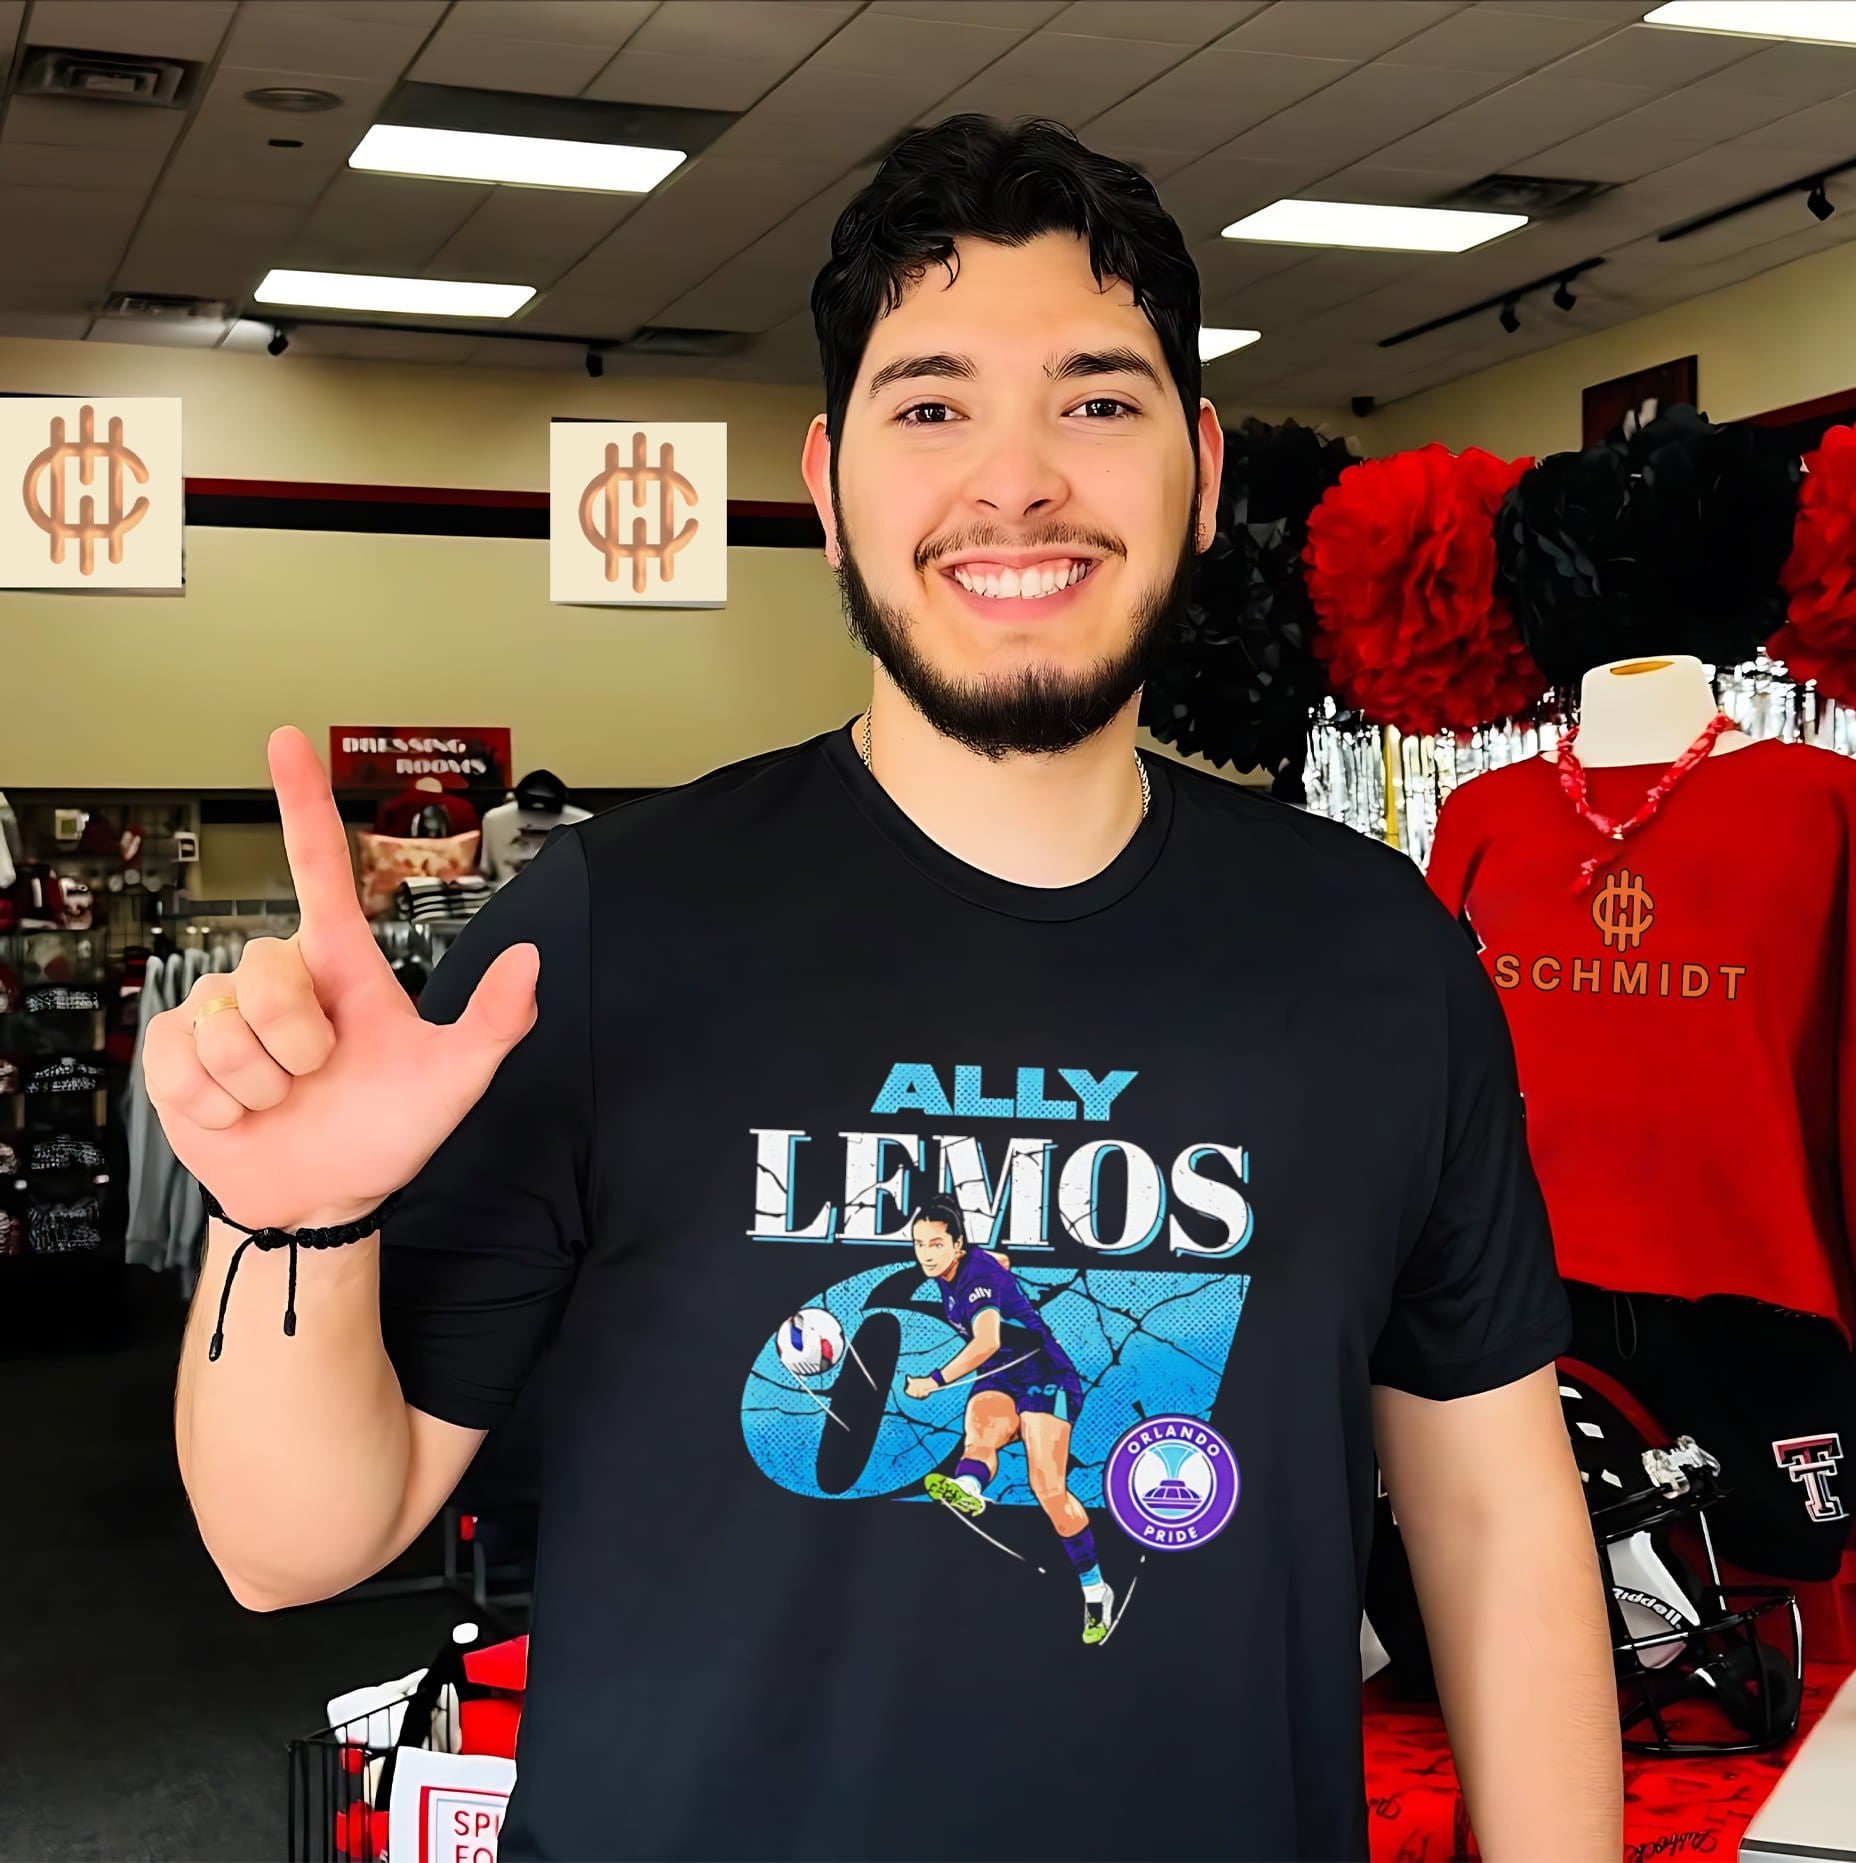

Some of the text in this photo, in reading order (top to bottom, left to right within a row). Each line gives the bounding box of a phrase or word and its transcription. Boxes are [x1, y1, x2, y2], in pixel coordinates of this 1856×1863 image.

[342, 737, 467, 754] DRESSING
[396, 758, 487, 775] ROOMS
[1494, 954, 1747, 1000] SCHMIDT
[869, 1062, 1140, 1122] ALLY
[746, 1128, 1256, 1258] LEMOS
[968, 1286, 992, 1303] ally
[1127, 1424, 1220, 1457] ORLANDO
[1143, 1525, 1198, 1543] PRIDE
